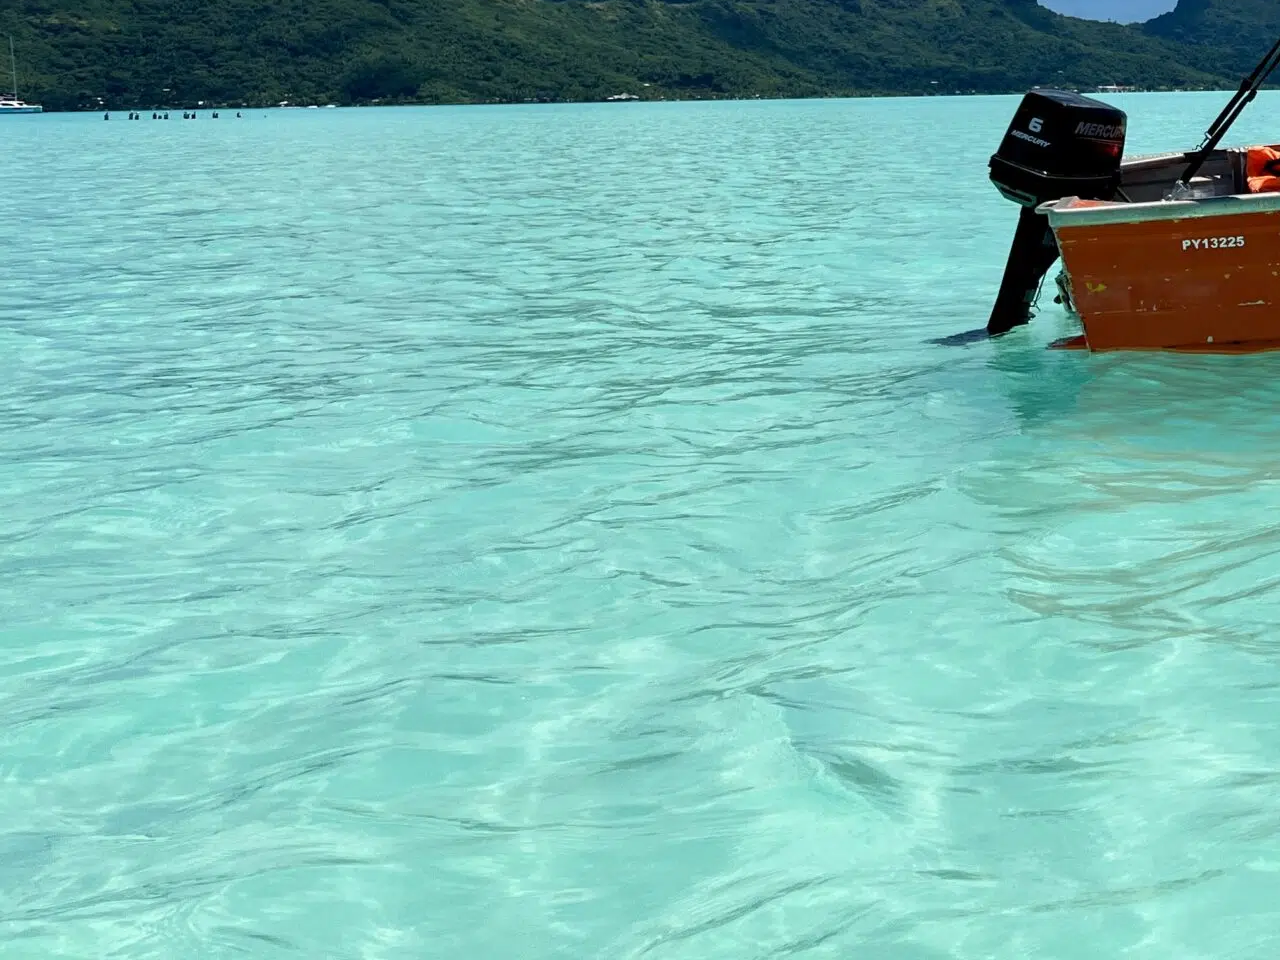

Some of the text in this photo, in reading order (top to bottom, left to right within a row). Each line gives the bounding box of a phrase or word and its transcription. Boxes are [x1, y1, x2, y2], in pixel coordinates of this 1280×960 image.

[1029, 117, 1044, 133] 6
[1074, 121, 1124, 138] MERCUR
[1011, 129, 1051, 147] MERCURY
[1182, 236, 1245, 251] PY13225
